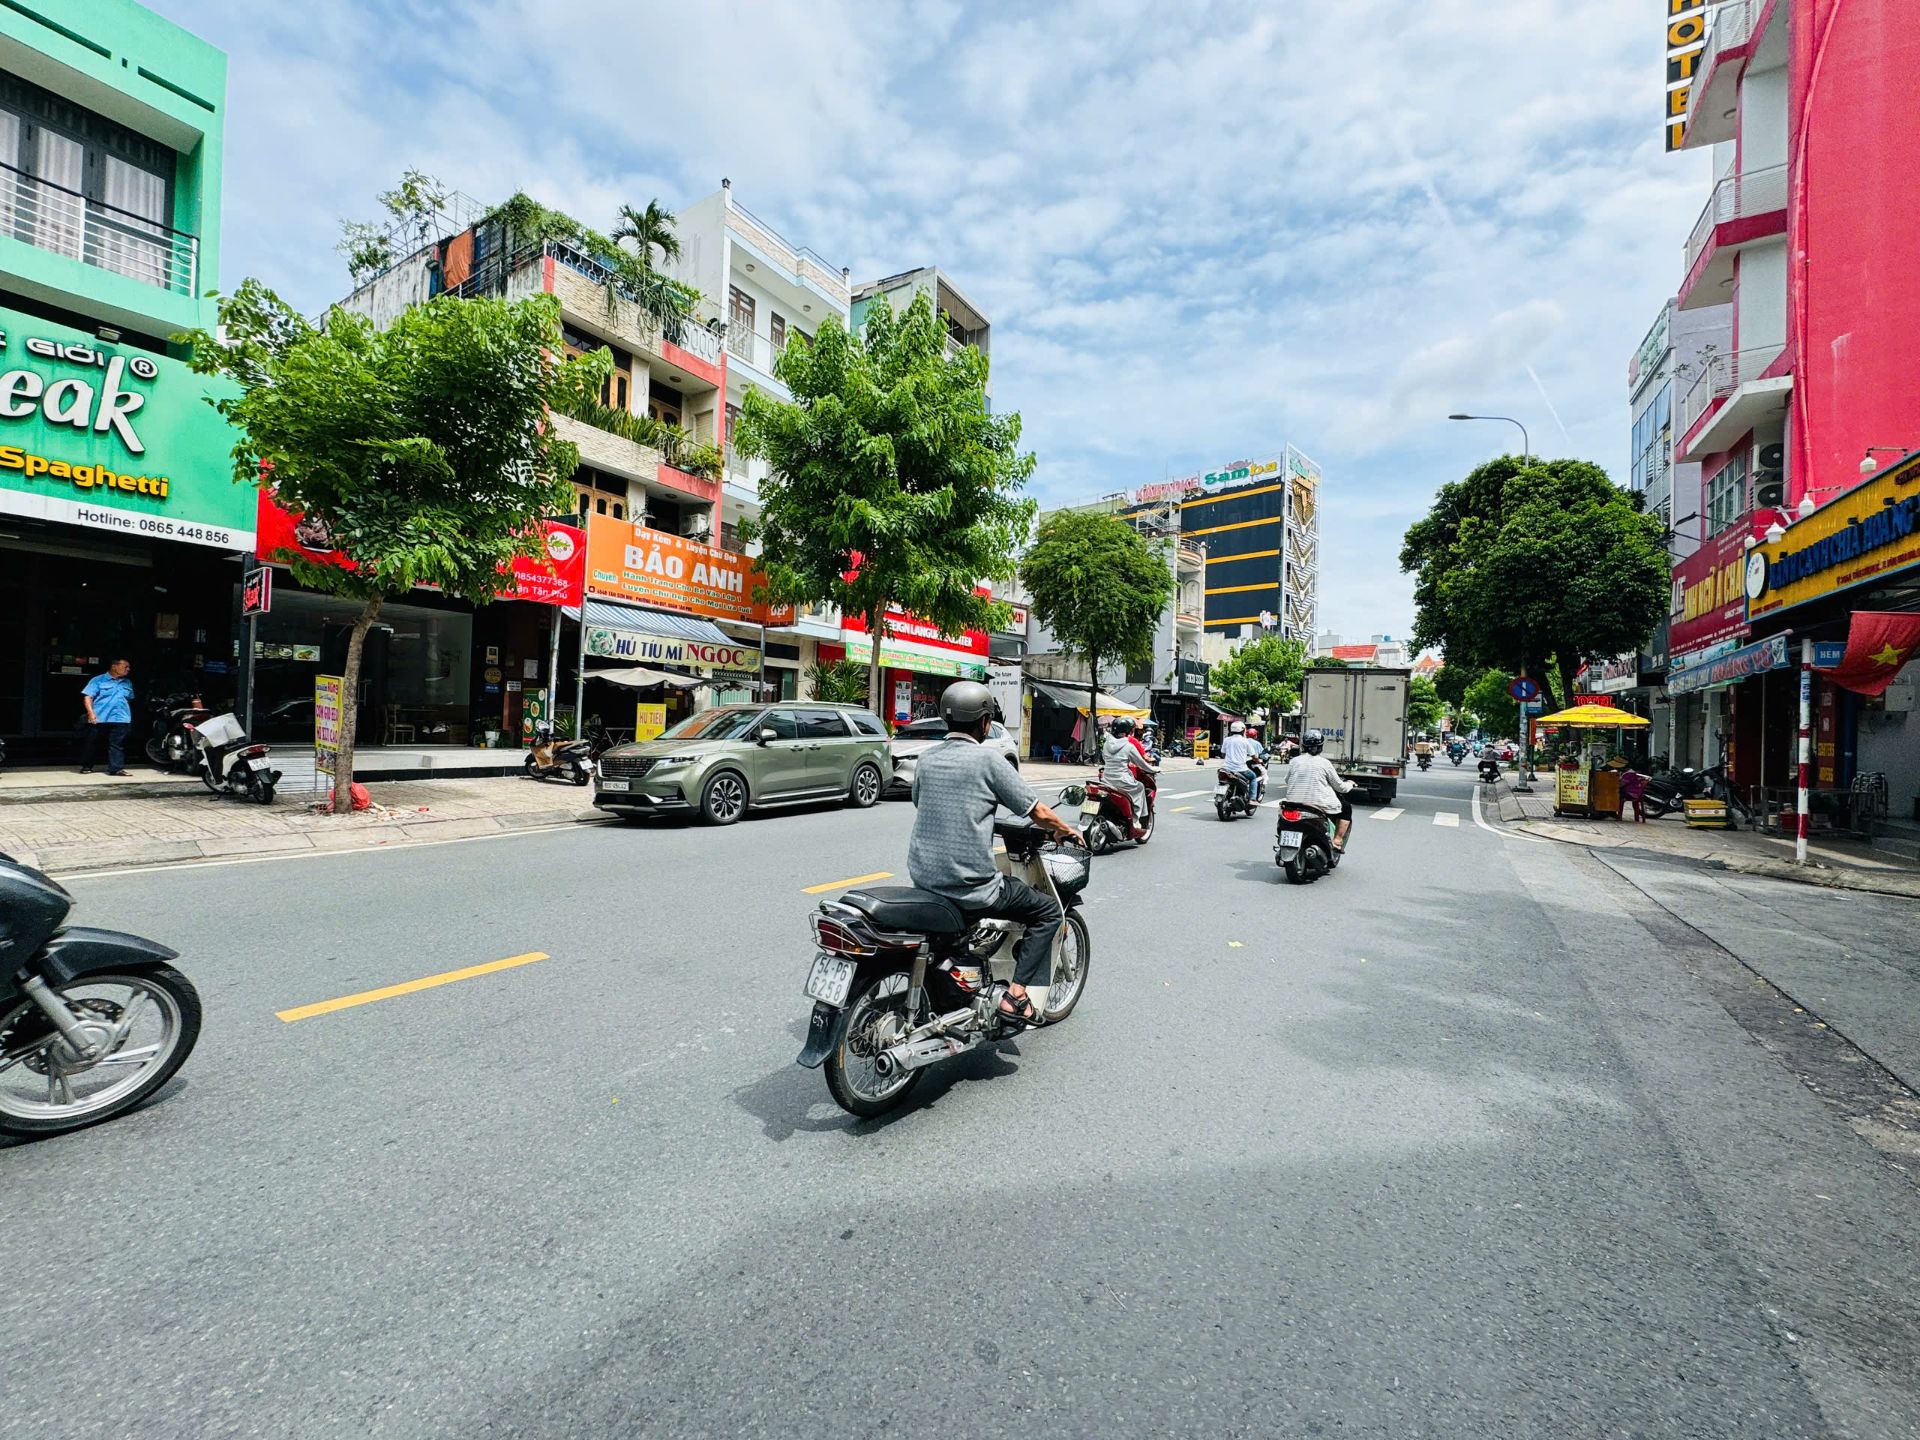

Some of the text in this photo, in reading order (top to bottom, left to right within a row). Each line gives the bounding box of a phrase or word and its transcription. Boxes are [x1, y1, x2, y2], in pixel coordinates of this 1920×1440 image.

[1204, 461, 1278, 485] Samba
[78, 508, 230, 544] Hotline: 0865 448 856
[624, 544, 743, 594] BẢO ANH
[686, 643, 745, 670] NGỌC
[810, 976, 842, 1001] 6258
